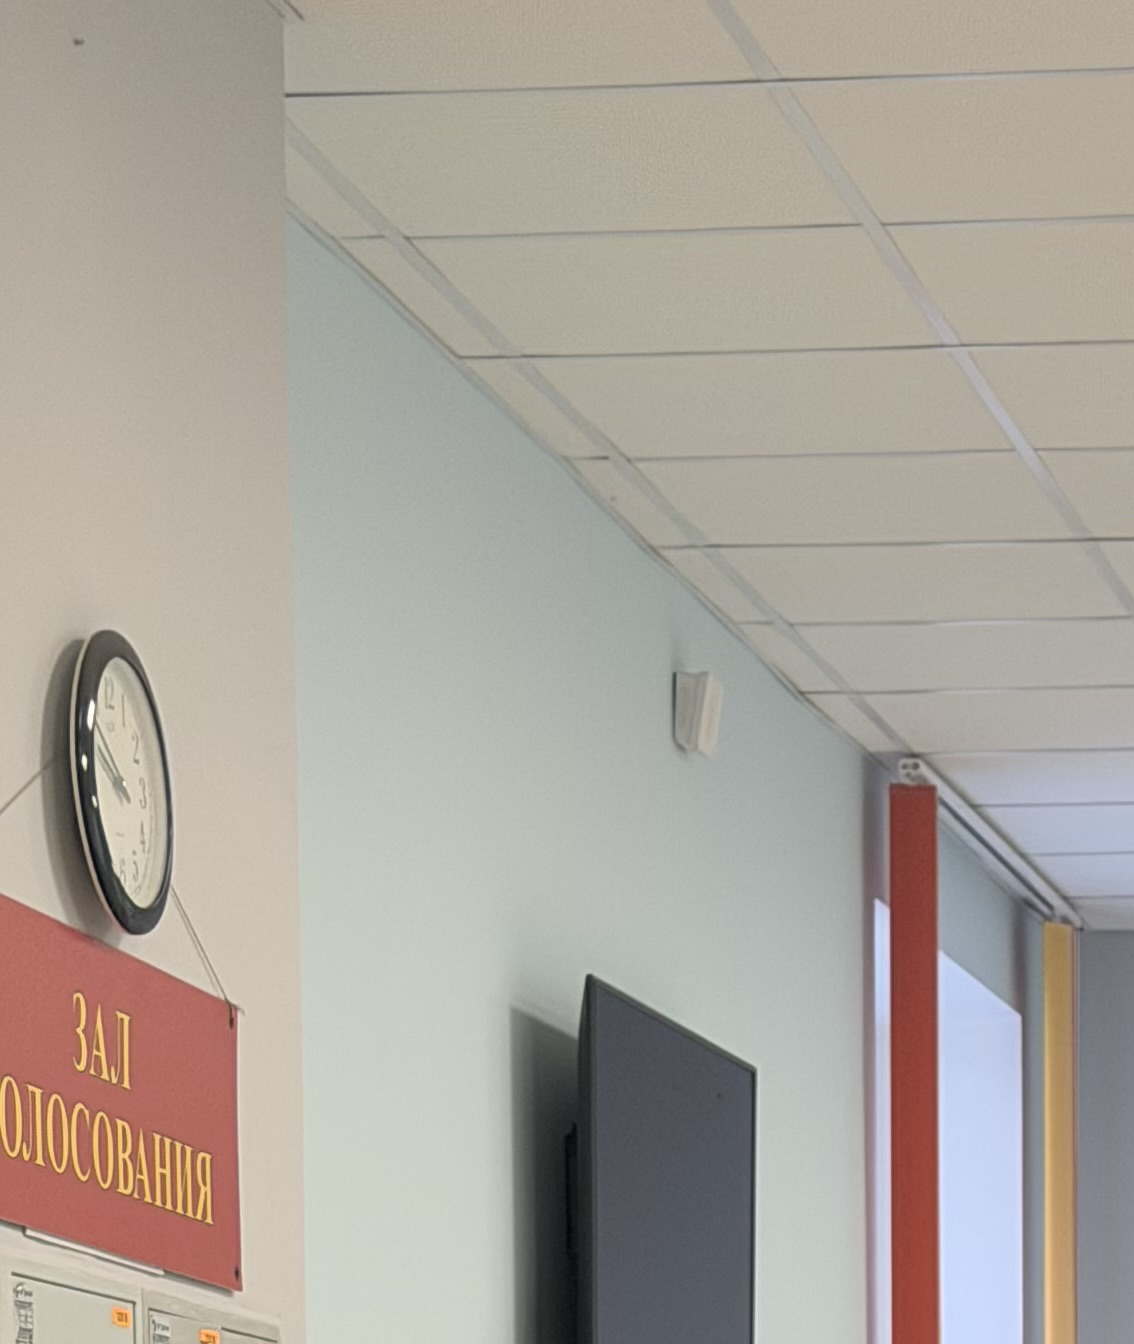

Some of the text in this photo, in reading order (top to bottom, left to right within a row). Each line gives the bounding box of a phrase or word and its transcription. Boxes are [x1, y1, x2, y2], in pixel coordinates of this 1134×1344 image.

[131, 734, 140, 766] 2
[138, 777, 147, 810] 3
[72, 992, 132, 1090] ЗАЛ
[0, 1074, 214, 1225] ОЛОСОВАНИЯ
